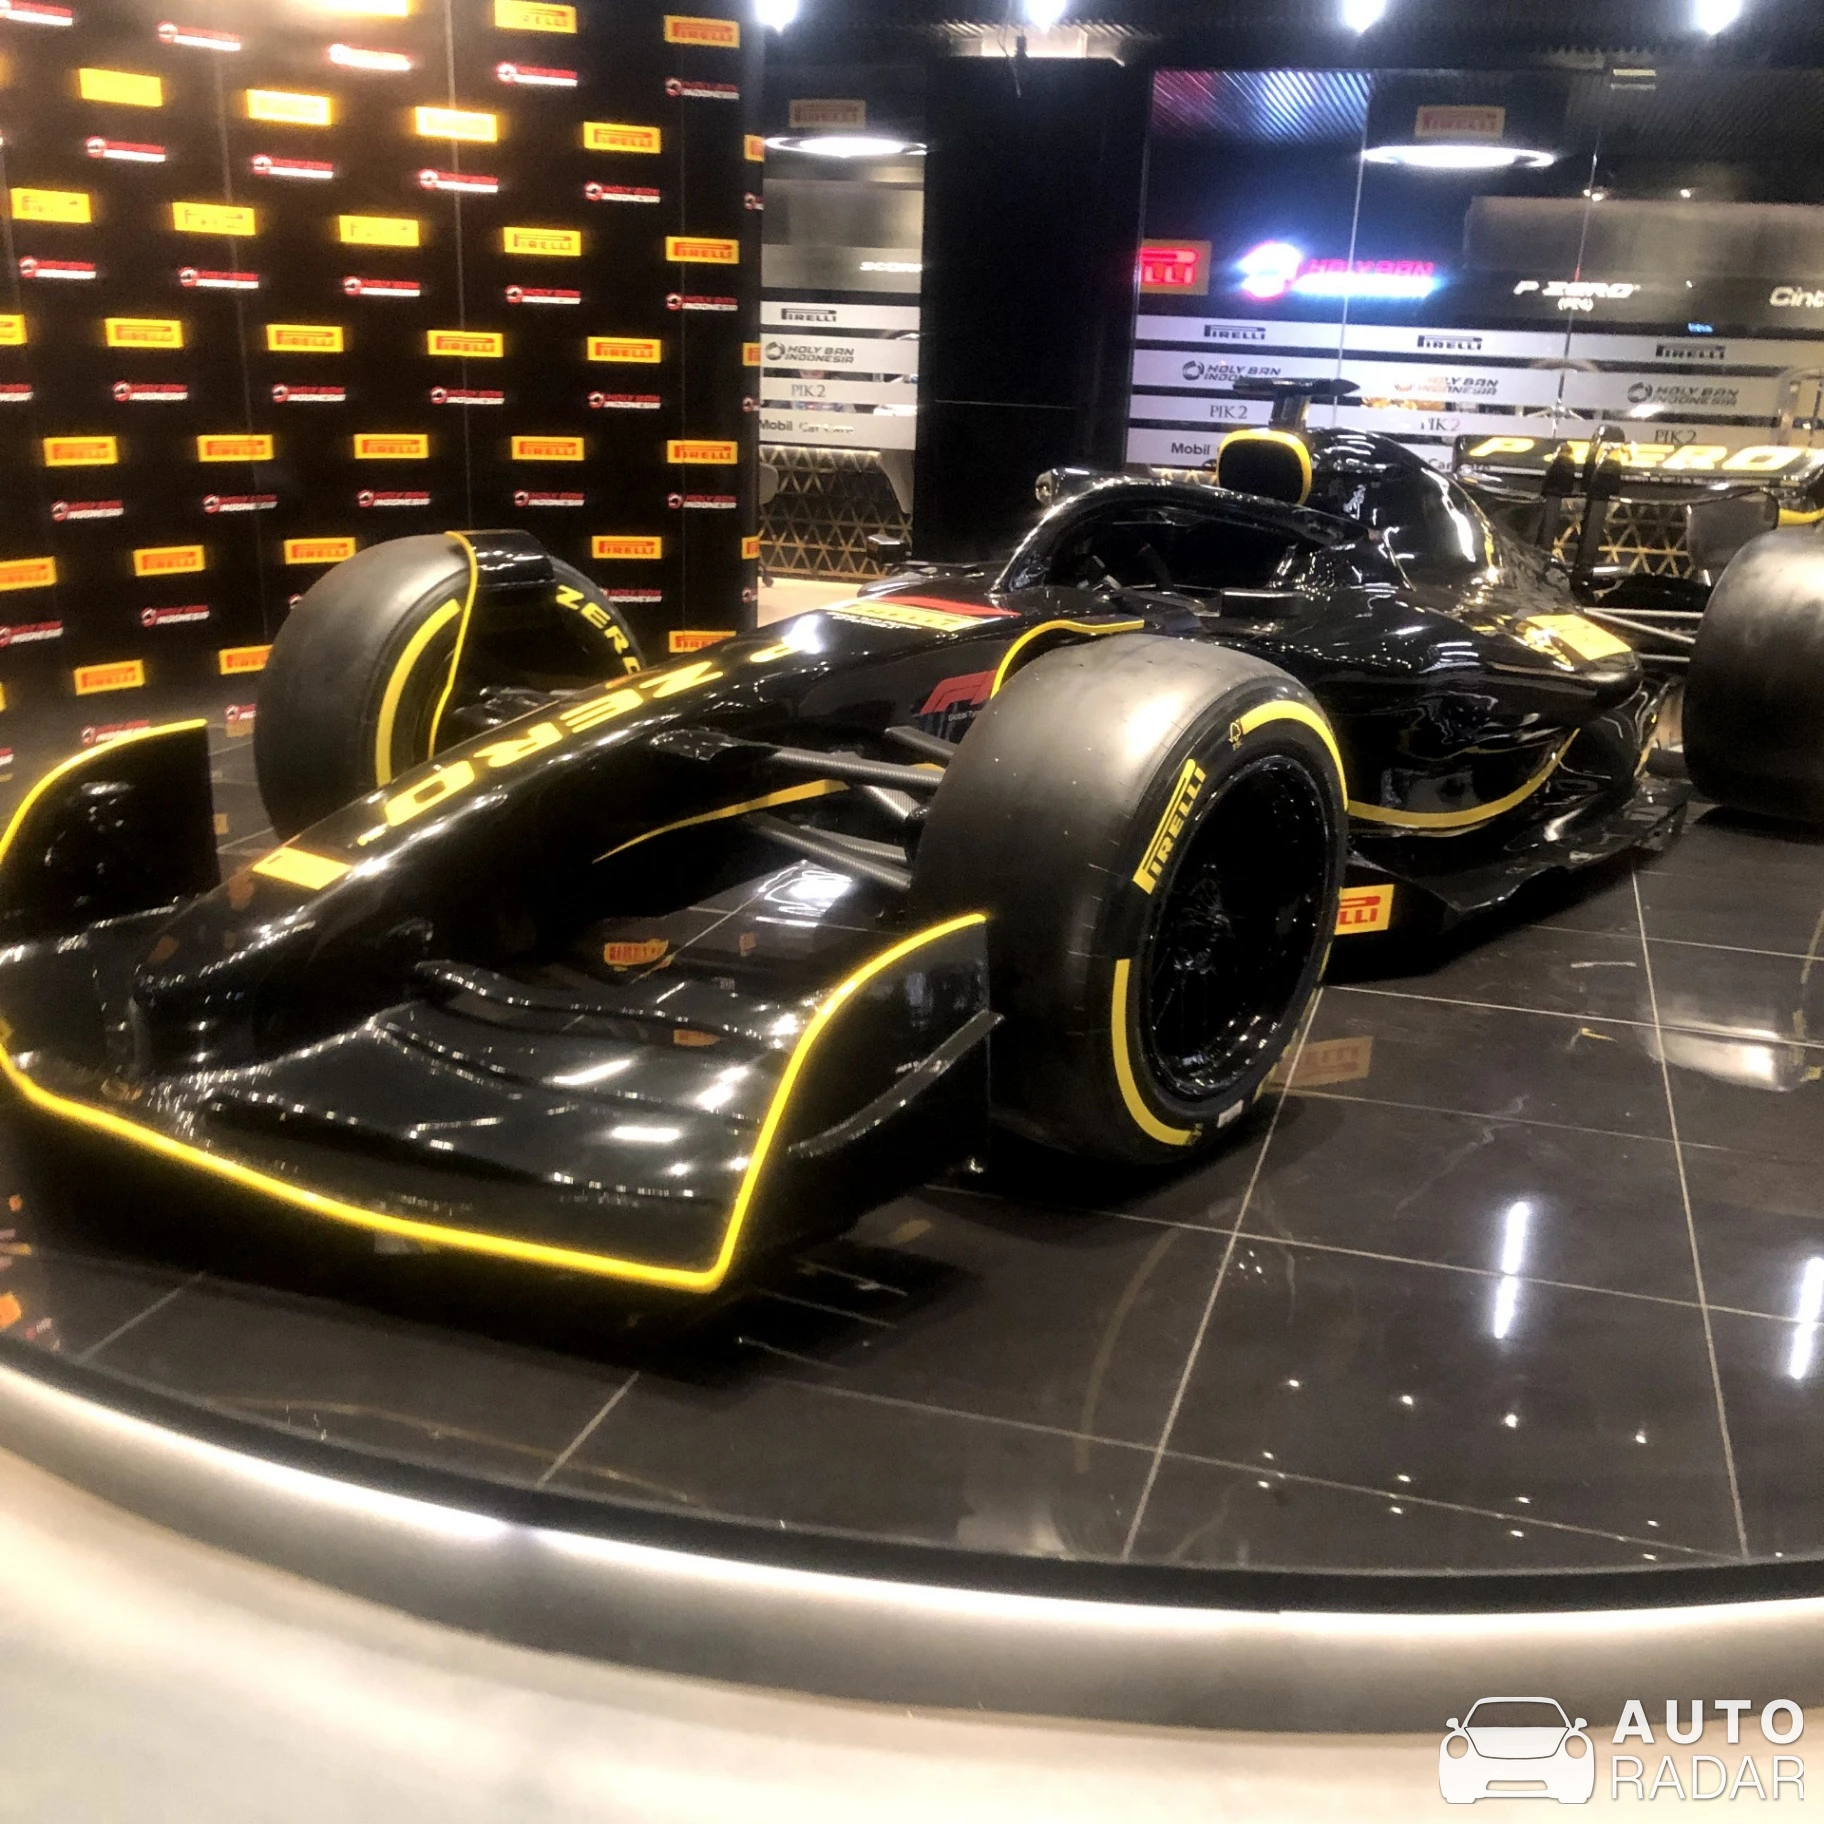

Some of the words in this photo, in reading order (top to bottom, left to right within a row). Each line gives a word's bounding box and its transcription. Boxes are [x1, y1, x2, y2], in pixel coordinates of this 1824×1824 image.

[671, 23, 733, 41] PIRELLI
[593, 128, 652, 147] PIRELLI
[673, 242, 733, 260] PIRELLI
[781, 308, 838, 323] PIRELLI
[1203, 325, 1265, 340] PIRELLI
[435, 335, 495, 352] PIRELLI
[594, 342, 654, 358] PIRELLI
[787, 345, 822, 355] HOLY
[1416, 335, 1483, 350] PIRELLI
[1655, 344, 1726, 361] PIRELLI
[1208, 364, 1245, 375] HOLY
[519, 441, 577, 456] PIRELLI
[673, 446, 732, 460] PIRELLI
[1171, 442, 1211, 456] Mobil
[1469, 436, 1535, 457] P
[291, 543, 349, 559] PIRELLI
[598, 540, 657, 555] PIRELLI
[1132, 757, 1207, 896] PIRELLI
